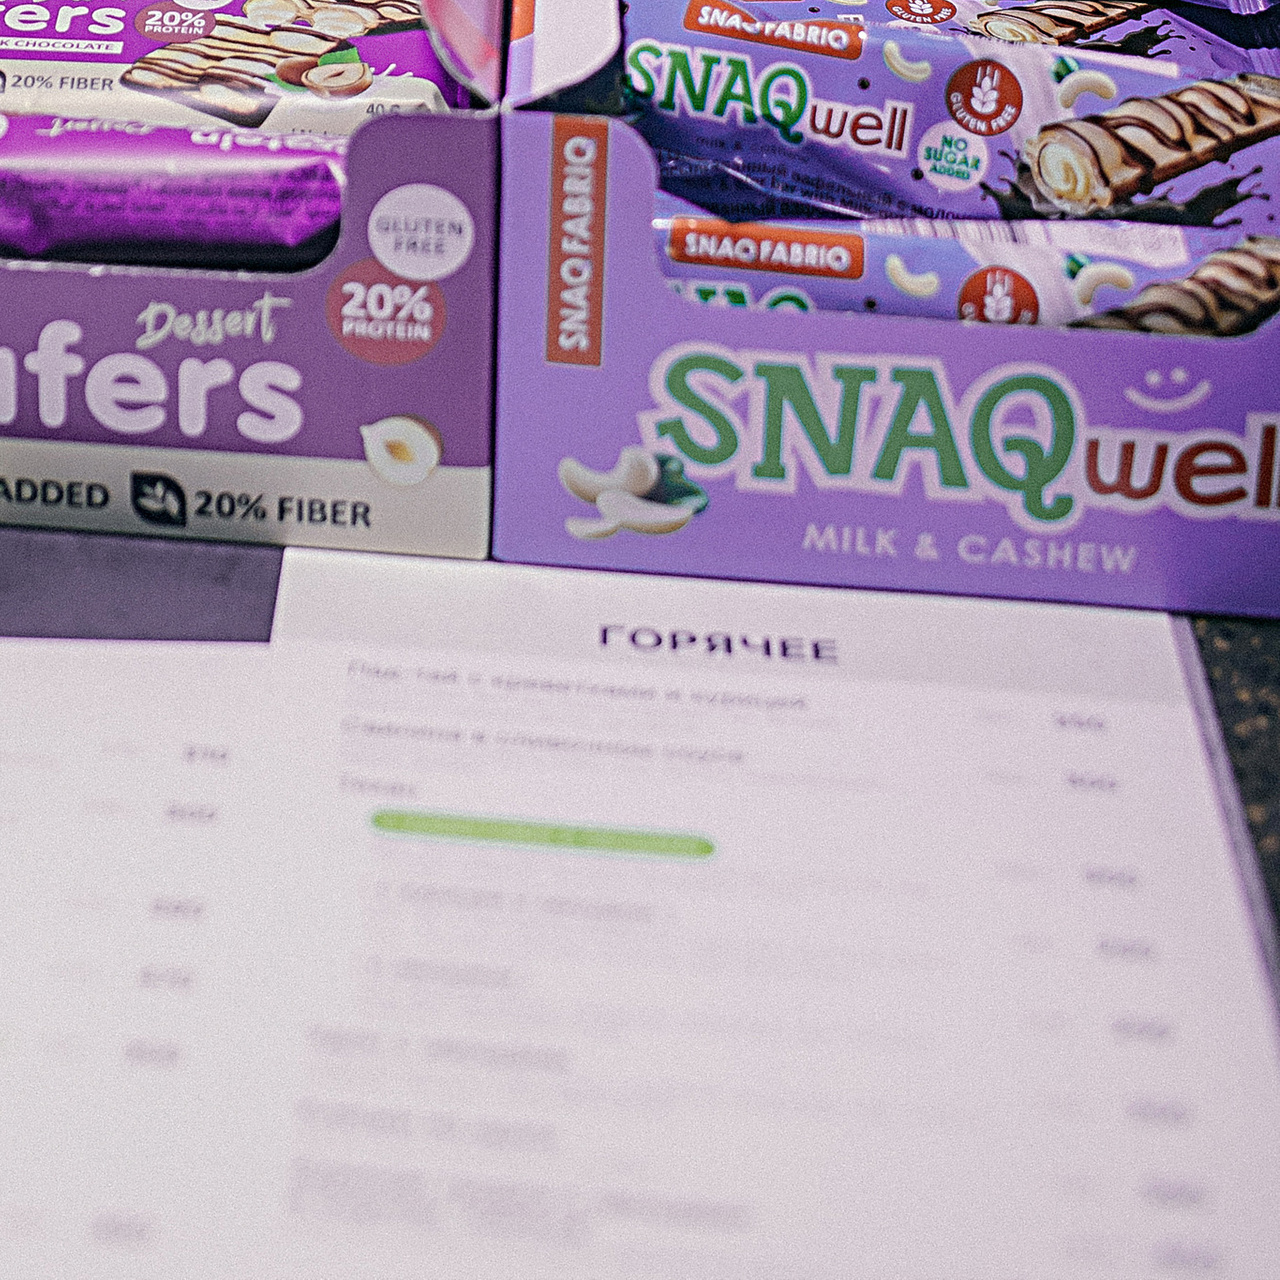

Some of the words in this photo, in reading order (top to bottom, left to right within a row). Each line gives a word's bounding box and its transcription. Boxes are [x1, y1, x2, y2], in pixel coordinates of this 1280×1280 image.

[145, 10, 206, 27] 20%
[892, 5, 932, 24] GLUTEN
[145, 25, 204, 35] PROTEIN
[10, 40, 114, 51] CHOCOLATE
[11, 75, 53, 90] 20%
[58, 77, 113, 91] FIBER
[949, 92, 986, 132] GLUTEN
[991, 102, 1016, 132] FREE
[941, 134, 968, 151] NO
[922, 147, 981, 171] SUGAR
[929, 164, 971, 180] ADDED
[376, 216, 465, 237] GLUTEN
[392, 237, 448, 256] FREE
[340, 281, 434, 320] 20%
[136, 292, 292, 349] Dessert
[343, 318, 432, 343] PROTEIN
[654, 350, 1280, 522] SNAQwel
[194, 490, 267, 523] 20%
[278, 496, 372, 529] FIBER
[801, 522, 898, 559] MILK
[914, 533, 942, 562] &
[956, 534, 1137, 573] CASHEW
[599, 624, 839, 664] ГОРЯЧЕЕ
